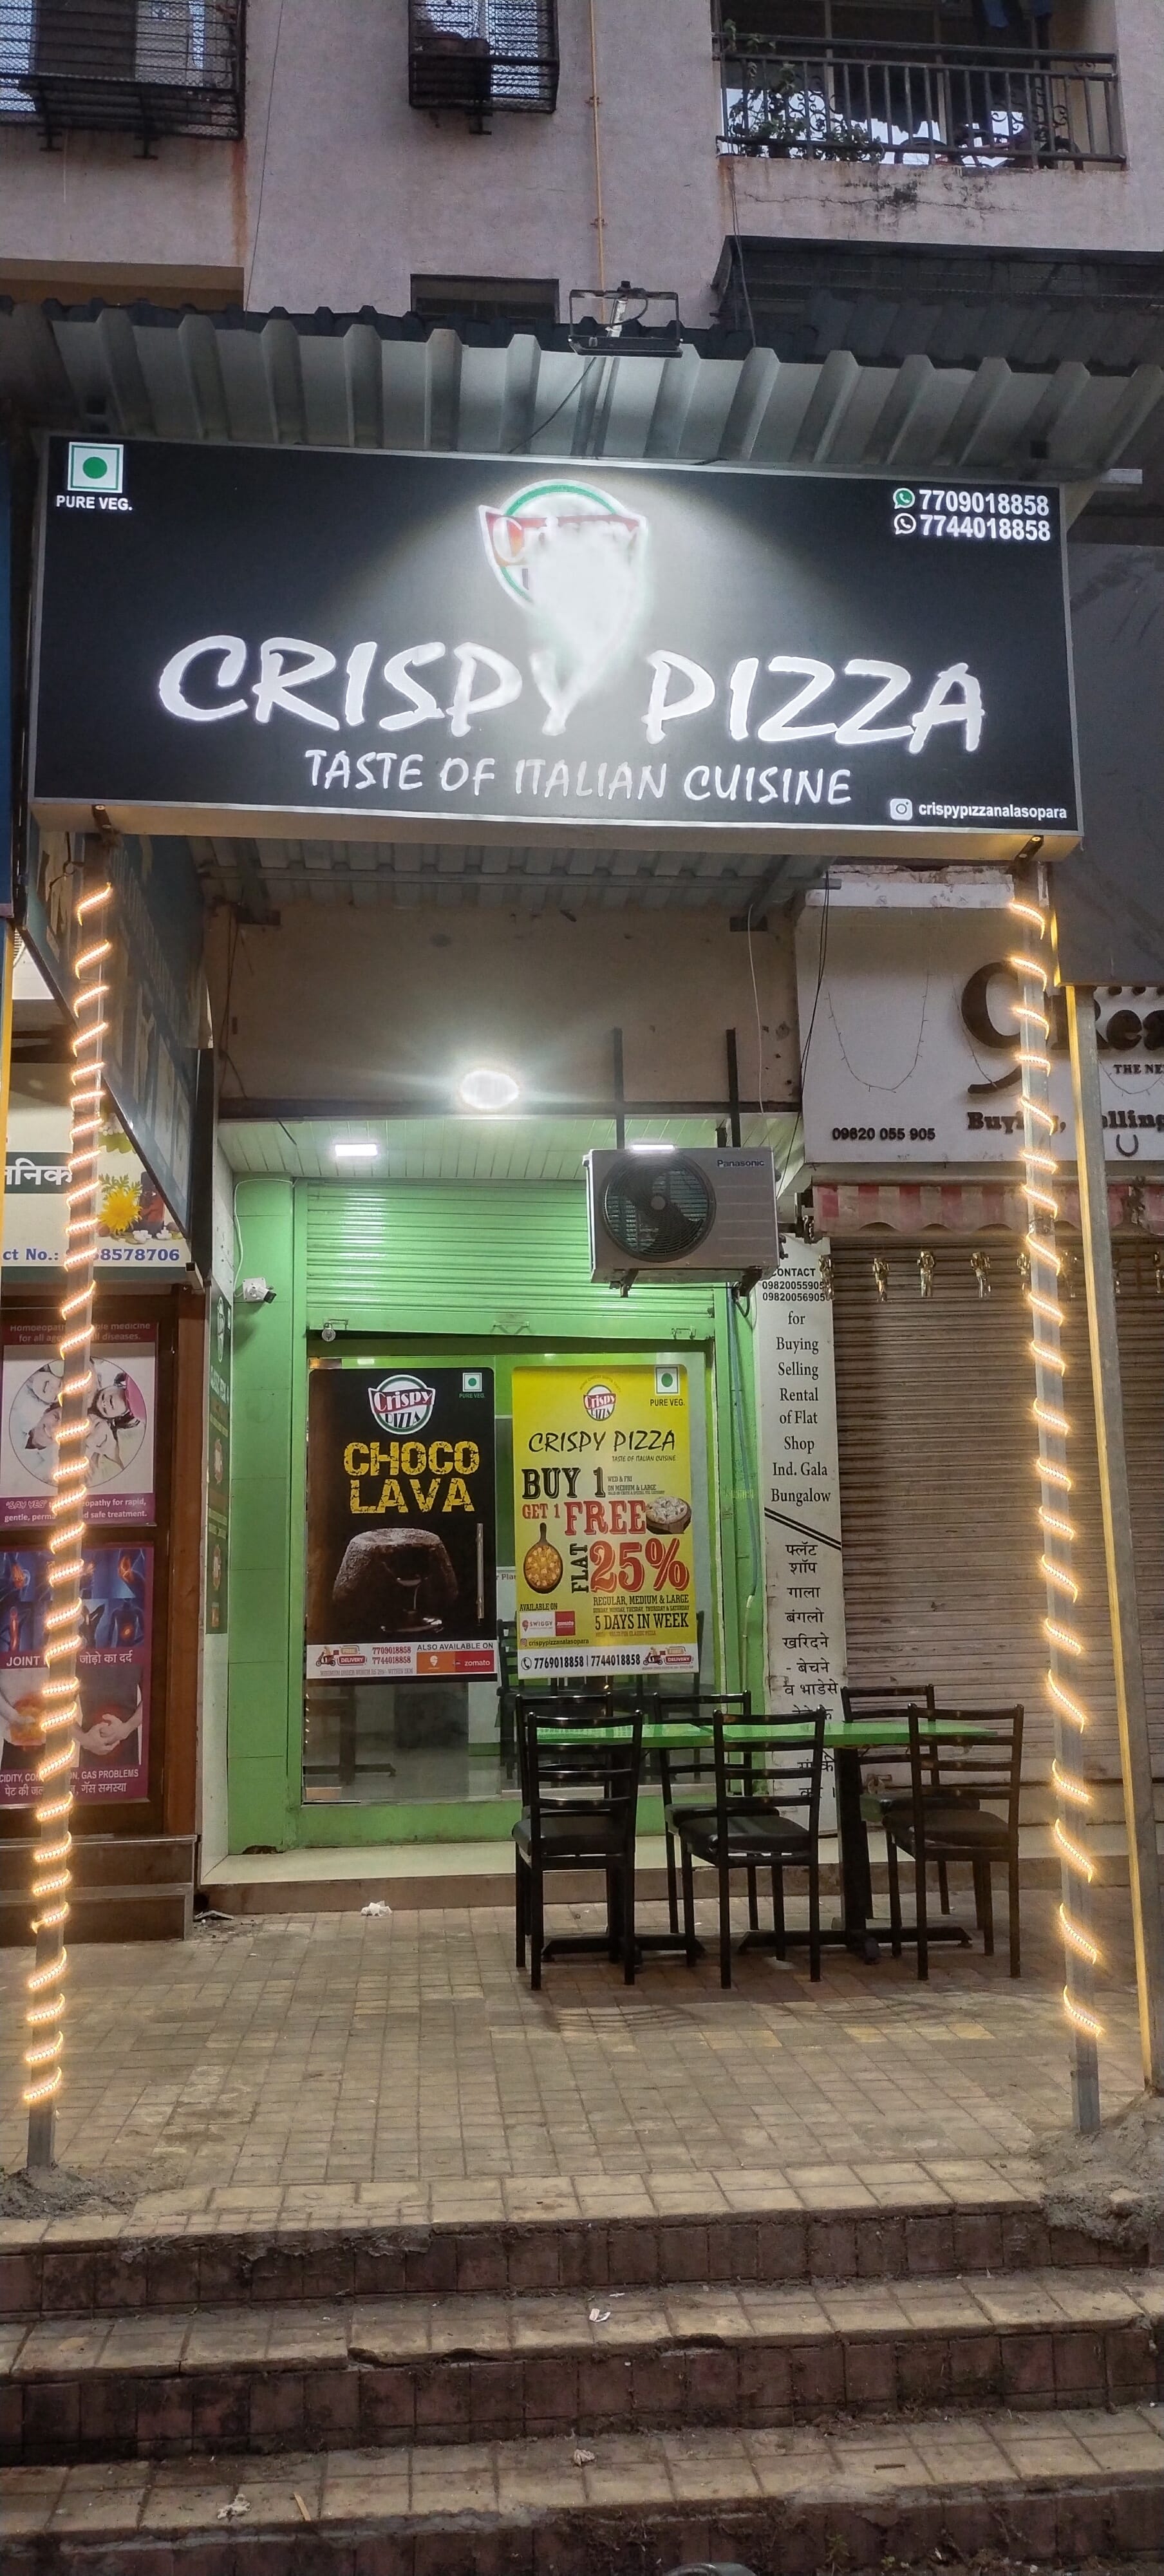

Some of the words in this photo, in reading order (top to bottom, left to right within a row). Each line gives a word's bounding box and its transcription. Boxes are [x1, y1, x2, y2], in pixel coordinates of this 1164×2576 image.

[56, 495, 95, 510] PURE
[99, 496, 133, 511] VEG.
[919, 489, 1050, 516] 7709018858
[921, 515, 1051, 542] 7744018858
[159, 634, 605, 738] CRISPY
[645, 650, 986, 754] PIZZA
[306, 749, 424, 790] TASTE
[441, 757, 494, 796] OF
[515, 760, 667, 801] ITALIAN
[684, 765, 852, 806] CUISINE
[919, 802, 1067, 823] crispypizzanalasopara
[1113, 1064, 1141, 1074] THE
[832, 1128, 874, 1141] 09820
[879, 1128, 905, 1141] 055
[910, 1128, 935, 1141] 905
[763, 1293, 825, 1301] 09820056905
[788, 1311, 805, 1325] for
[776, 1336, 819, 1354] Buying
[778, 1362, 819, 1381] Selling
[373, 1391, 432, 1412] Crispy
[585, 1395, 615, 1408] Crispy
[780, 1387, 819, 1401] Rental
[780, 1410, 794, 1424] of
[794, 1410, 818, 1424] Flat
[529, 1431, 606, 1452] CRISPY
[614, 1430, 675, 1452] PIZZA
[784, 1436, 814, 1454] Shop
[344, 1441, 480, 1476] CHOCO
[773, 1462, 797, 1476] Ind.
[801, 1462, 828, 1476] Gala
[521, 1467, 581, 1499] BUY
[593, 1466, 605, 1497] 1
[125, 1498, 146, 1507] rapid,
[350, 1478, 475, 1513] LAVA
[771, 1488, 831, 1508] Bungalow
[5, 1514, 30, 1522] gentle,
[522, 1503, 549, 1519] GET
[554, 1503, 560, 1519] 1
[564, 1500, 646, 1535] FREE
[569, 1543, 589, 1593] FLAT
[589, 1537, 690, 1593] 25%
[789, 1558, 818, 1574] शॉप
[593, 1596, 627, 1606] REGULAR,
[629, 1595, 658, 1604] MEDIUM
[659, 1595, 664, 1604] &
[666, 1595, 689, 1603] LARGE
[787, 1587, 821, 1599] गाला
[595, 1616, 601, 1630] 5
[604, 1614, 634, 1630] DAYS
[637, 1614, 650, 1629] IN
[653, 1613, 689, 1628] WEEK
[785, 1611, 825, 1624] बंगलो
[783, 1632, 829, 1649] खरिदने
[372, 1646, 411, 1654] 7709018858
[6, 1656, 40, 1667] JOINT
[104, 1654, 117, 1663] का
[372, 1656, 411, 1665] 7744018858
[534, 1656, 583, 1669] 7769018858
[591, 1654, 641, 1667] 7744018858
[797, 1658, 829, 1674] बेचने
[82, 1771, 97, 1779] GAS
[99, 1769, 138, 1778] PROBLEMS
